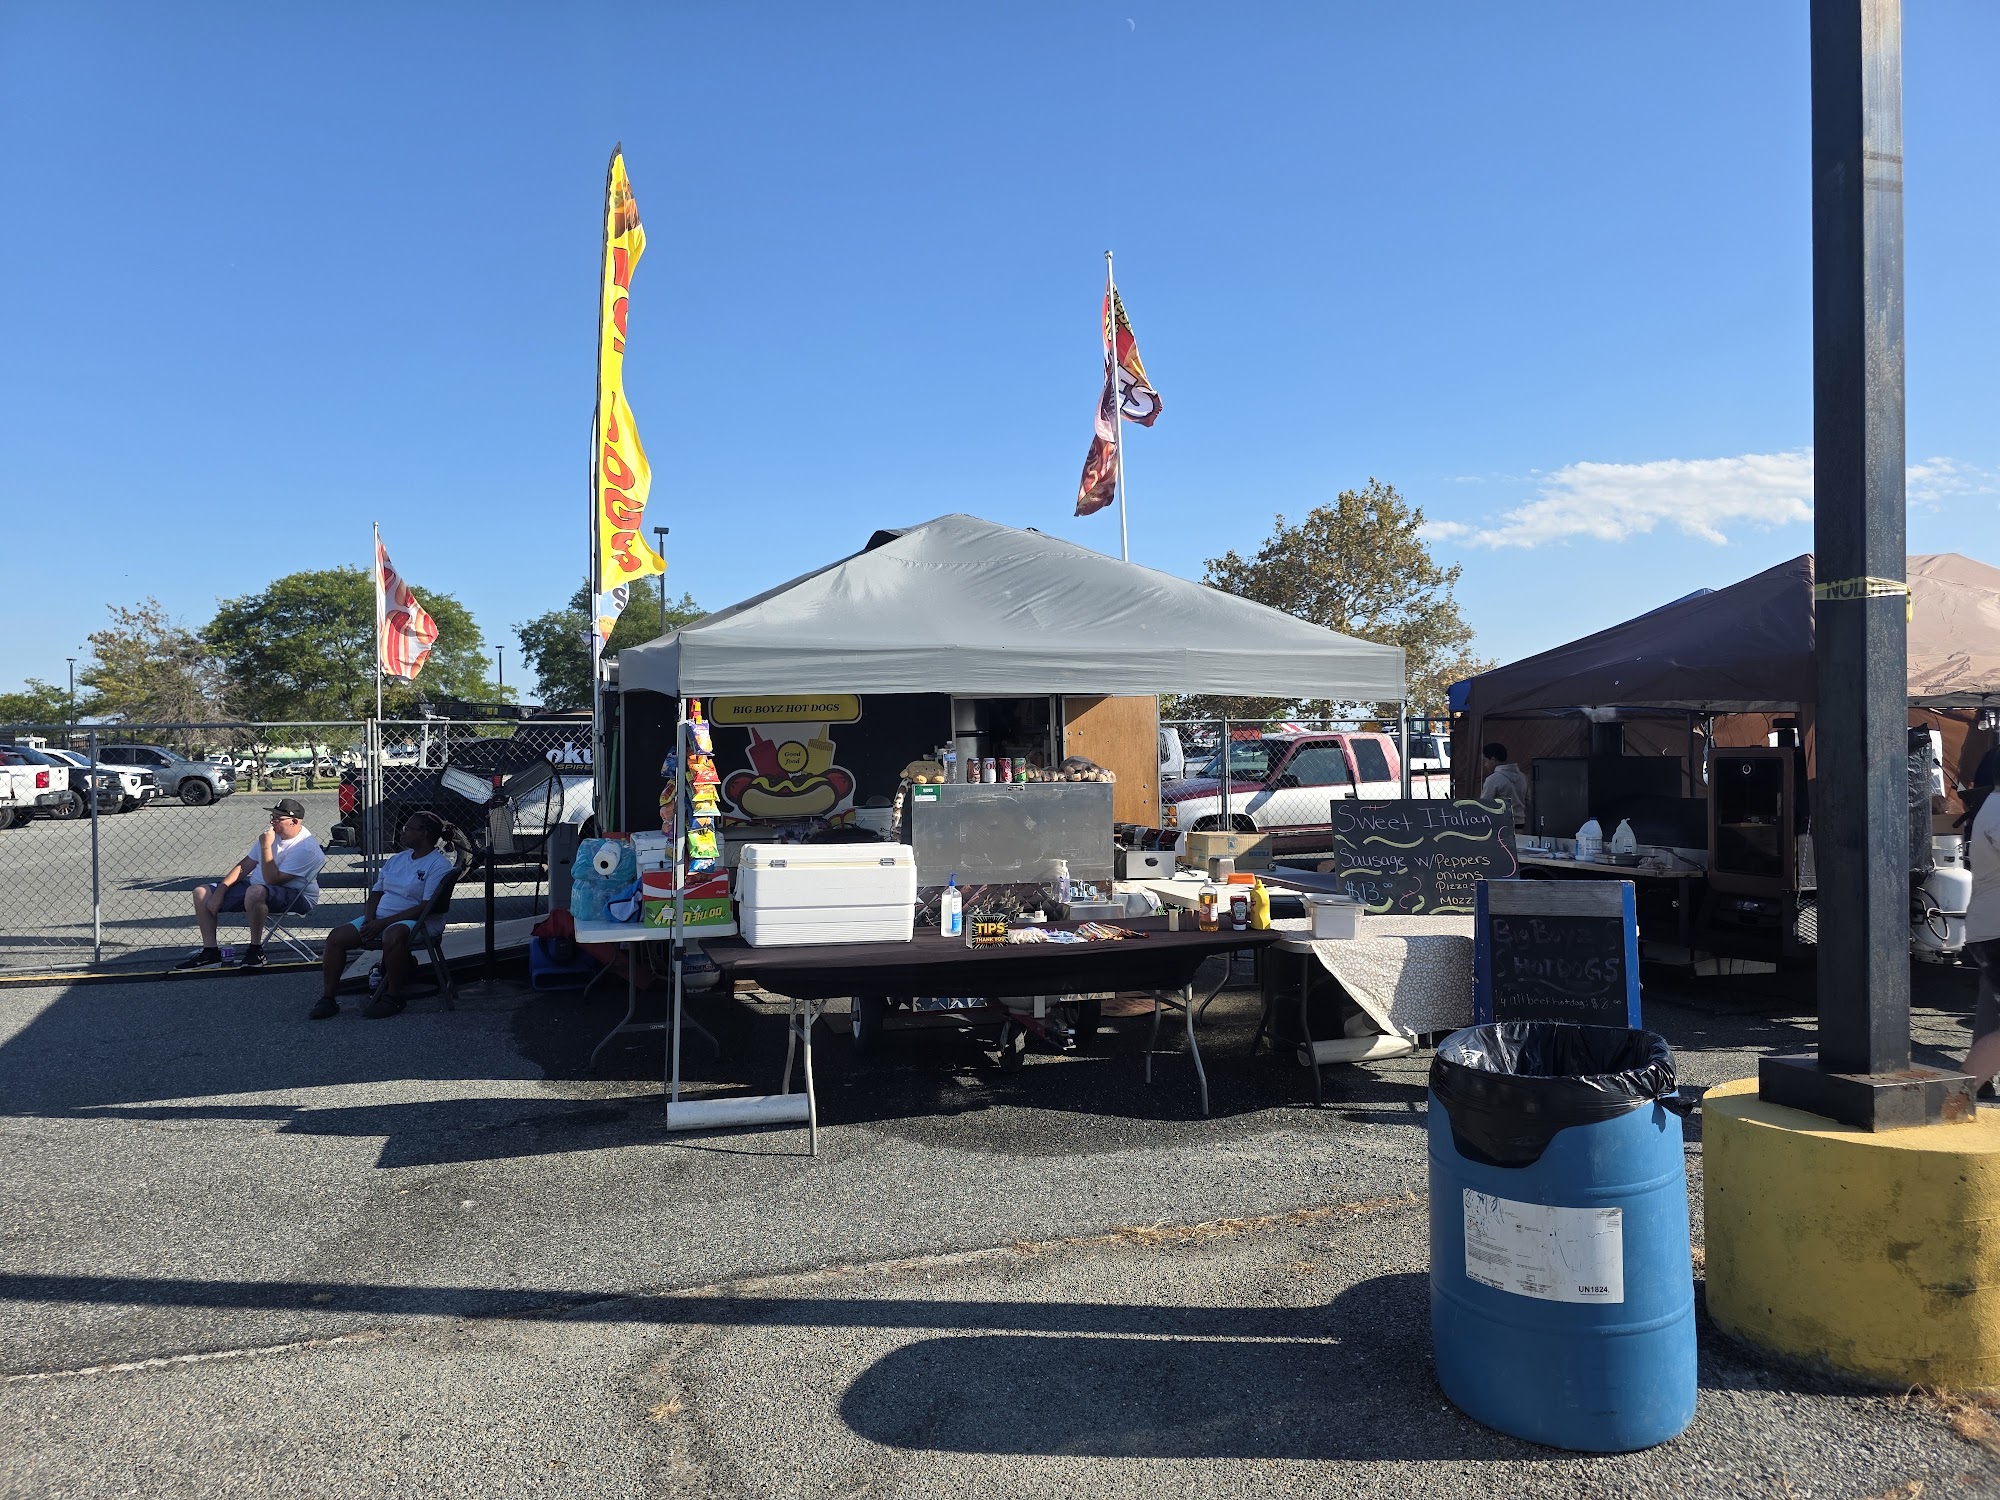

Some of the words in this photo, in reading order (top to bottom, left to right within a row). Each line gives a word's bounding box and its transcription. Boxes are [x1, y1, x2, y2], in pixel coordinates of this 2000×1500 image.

[733, 705, 753, 714] BIG
[754, 704, 784, 714] BOYZ
[785, 704, 810, 713] HOT
[811, 703, 840, 713] DOGS
[546, 742, 593, 764] oku
[784, 758, 801, 766] food
[1338, 806, 1412, 832] Sweet
[1418, 807, 1491, 828] Italian
[1340, 848, 1407, 874] Sausage
[1436, 869, 1484, 880] onions
[691, 910, 708, 922] THE
[975, 922, 1005, 934] TIPS
[975, 936, 995, 944] THANK
[1526, 993, 1550, 1006] beef
